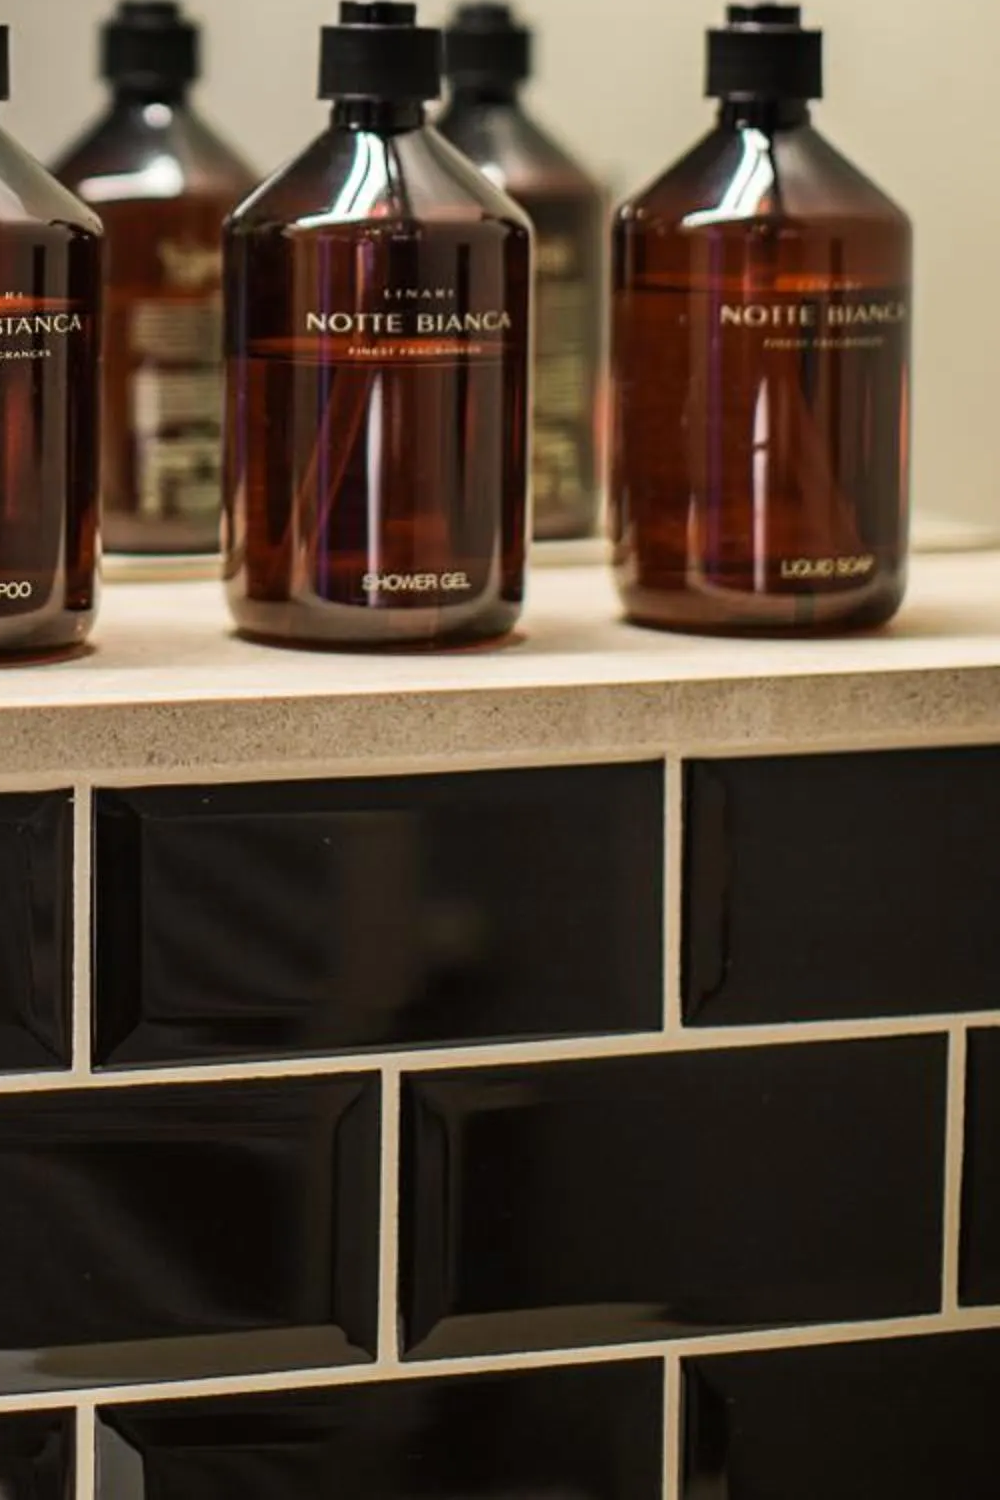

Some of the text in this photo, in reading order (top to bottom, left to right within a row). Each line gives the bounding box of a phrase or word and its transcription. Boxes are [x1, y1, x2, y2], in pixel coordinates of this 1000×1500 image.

[306, 310, 512, 333] NOTTE BIANCA
[720, 304, 815, 326] NOTTE
[781, 558, 834, 579] LIQUID
[362, 572, 472, 591] SHOWER GEL
